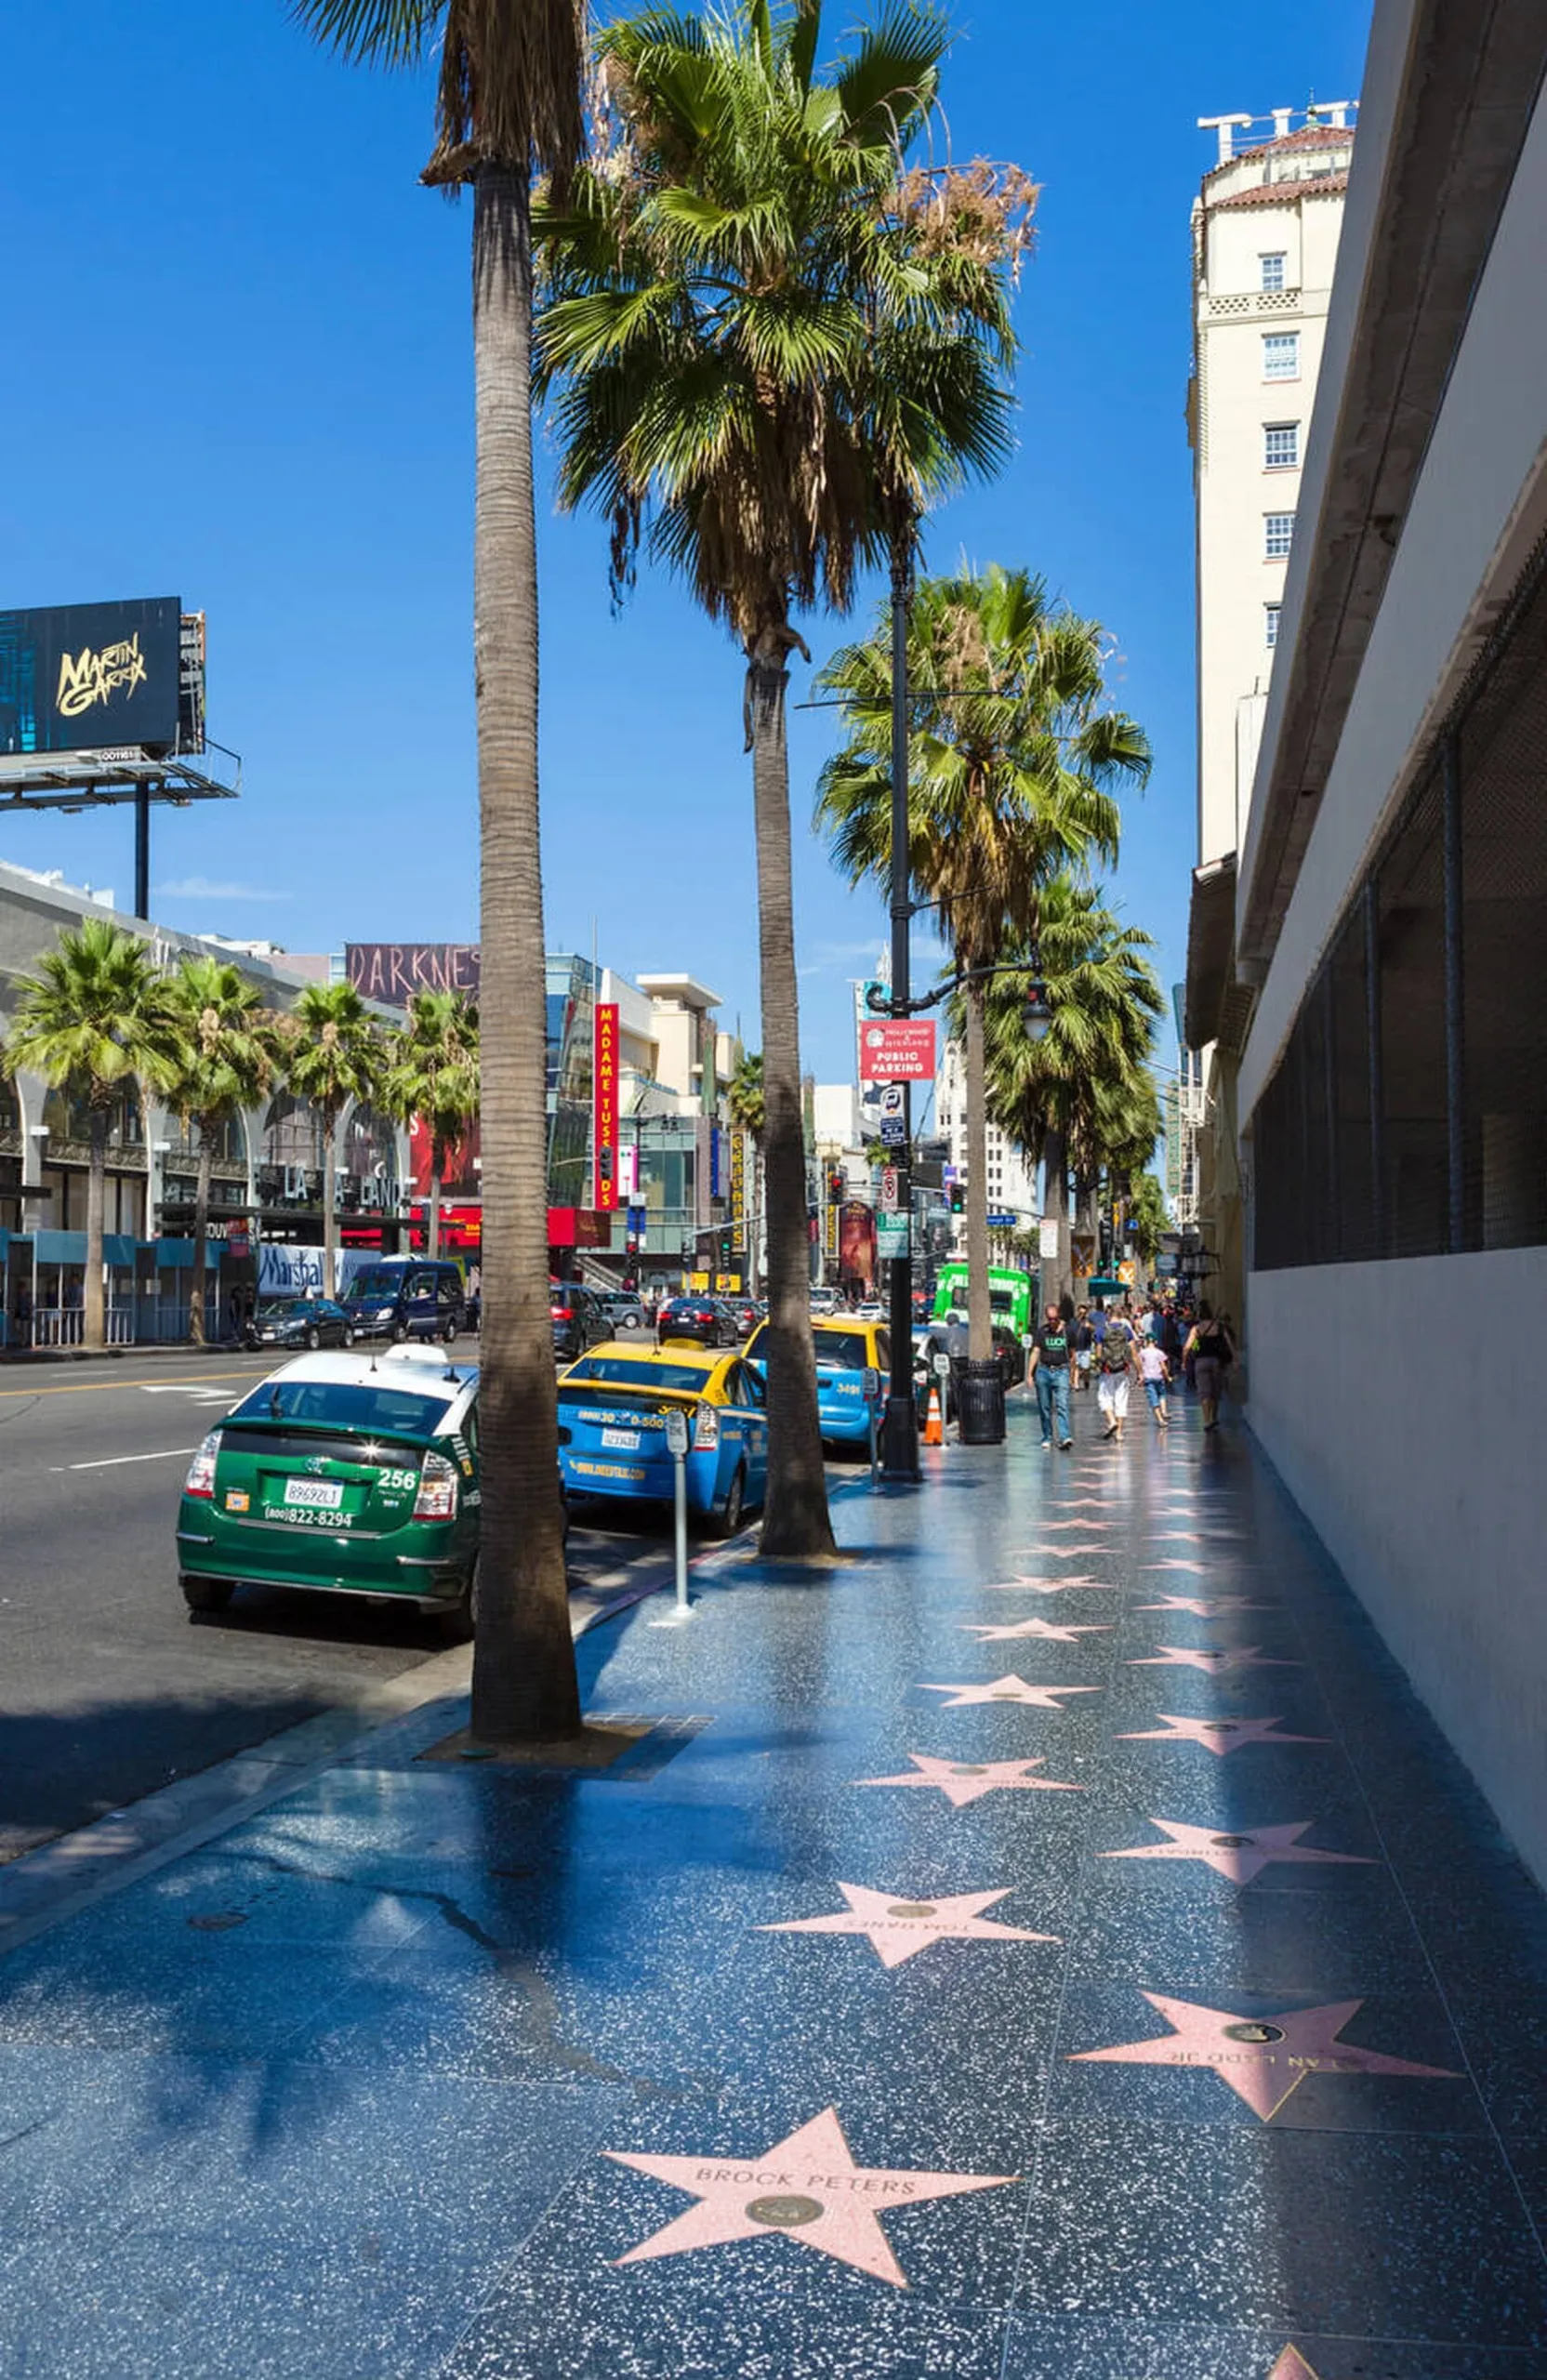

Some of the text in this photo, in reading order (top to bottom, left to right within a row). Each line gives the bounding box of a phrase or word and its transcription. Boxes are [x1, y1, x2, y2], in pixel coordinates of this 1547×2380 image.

[600, 1009, 613, 1091] MADAME
[877, 1051, 919, 1062] PUBLIC
[870, 1063, 923, 1073] PARKING
[284, 1165, 308, 1199] LA
[377, 1469, 416, 1488] 256
[696, 2167, 916, 2195] BROCK PETERS
